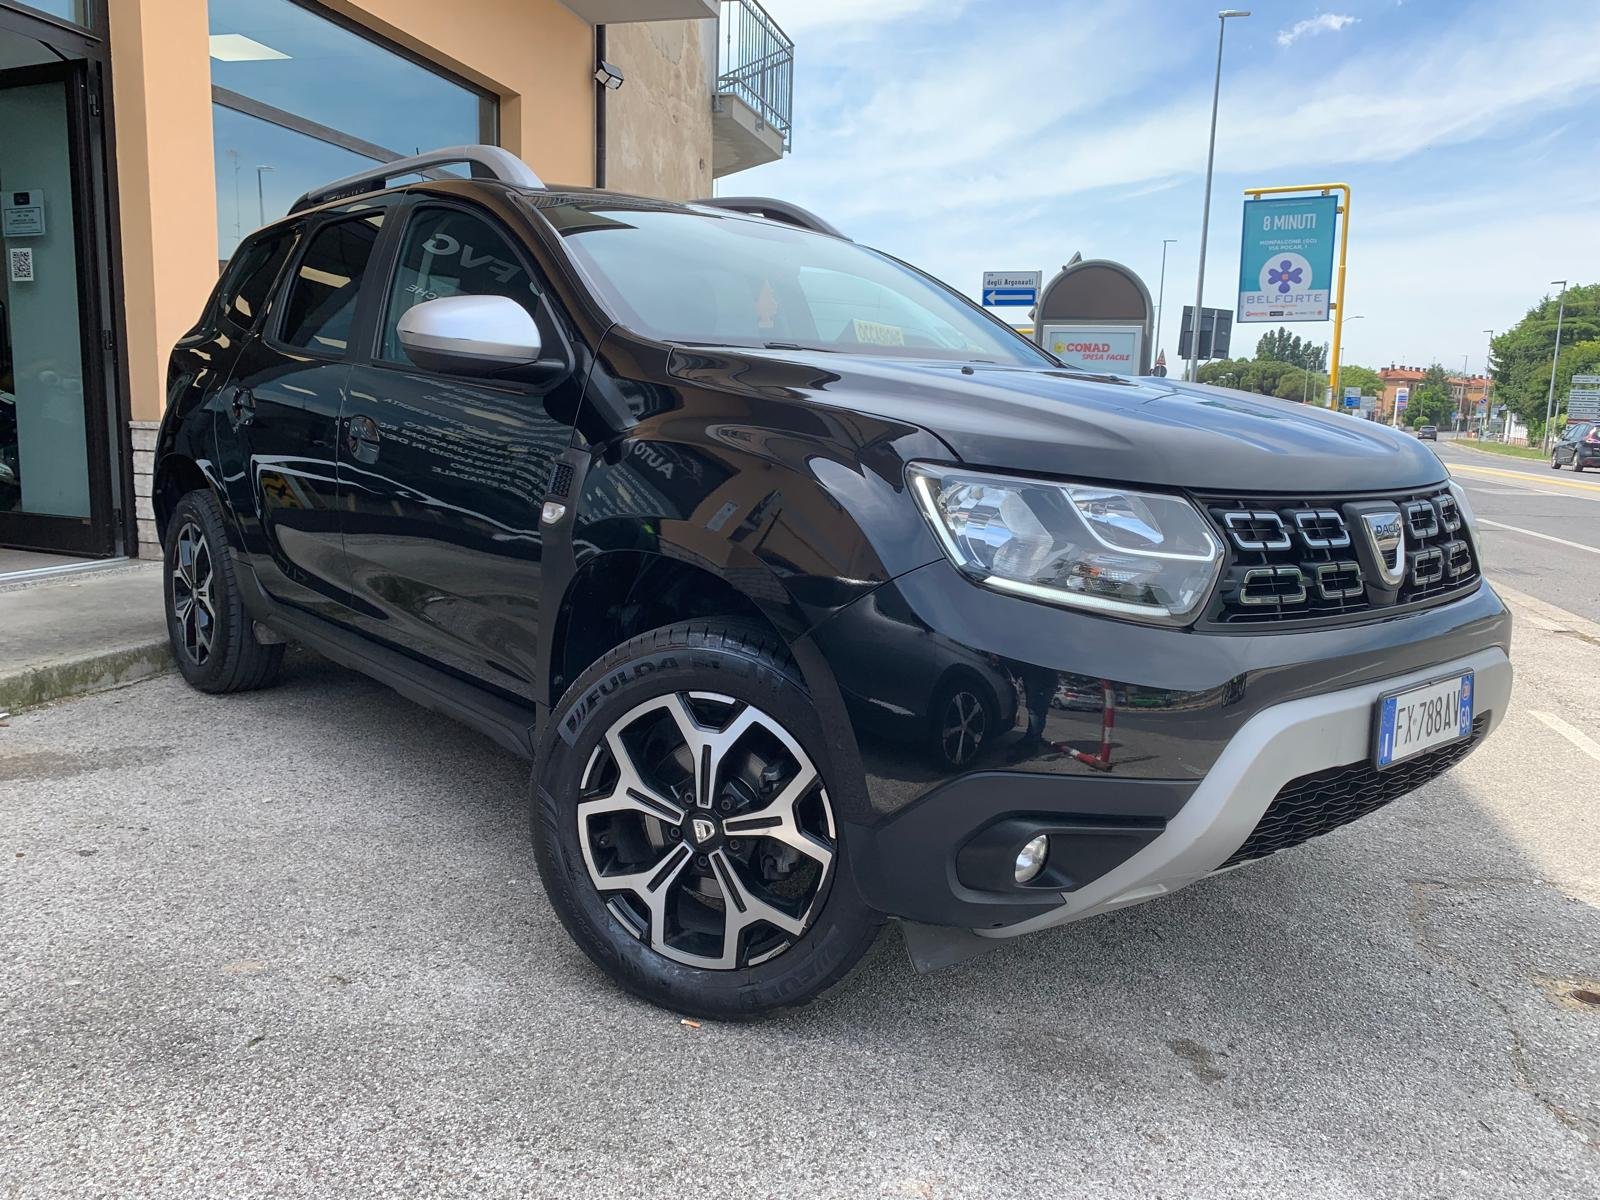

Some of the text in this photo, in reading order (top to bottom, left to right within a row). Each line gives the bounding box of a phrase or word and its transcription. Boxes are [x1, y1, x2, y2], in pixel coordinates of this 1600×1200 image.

[1263, 213, 1316, 231] 8 MINUTI
[987, 279, 1034, 287] degli Argonauti
[1246, 294, 1322, 304] BELFORTE
[1066, 343, 1111, 353] CONAD
[1376, 523, 1400, 535] DACIA
[585, 657, 680, 708] FULDA
